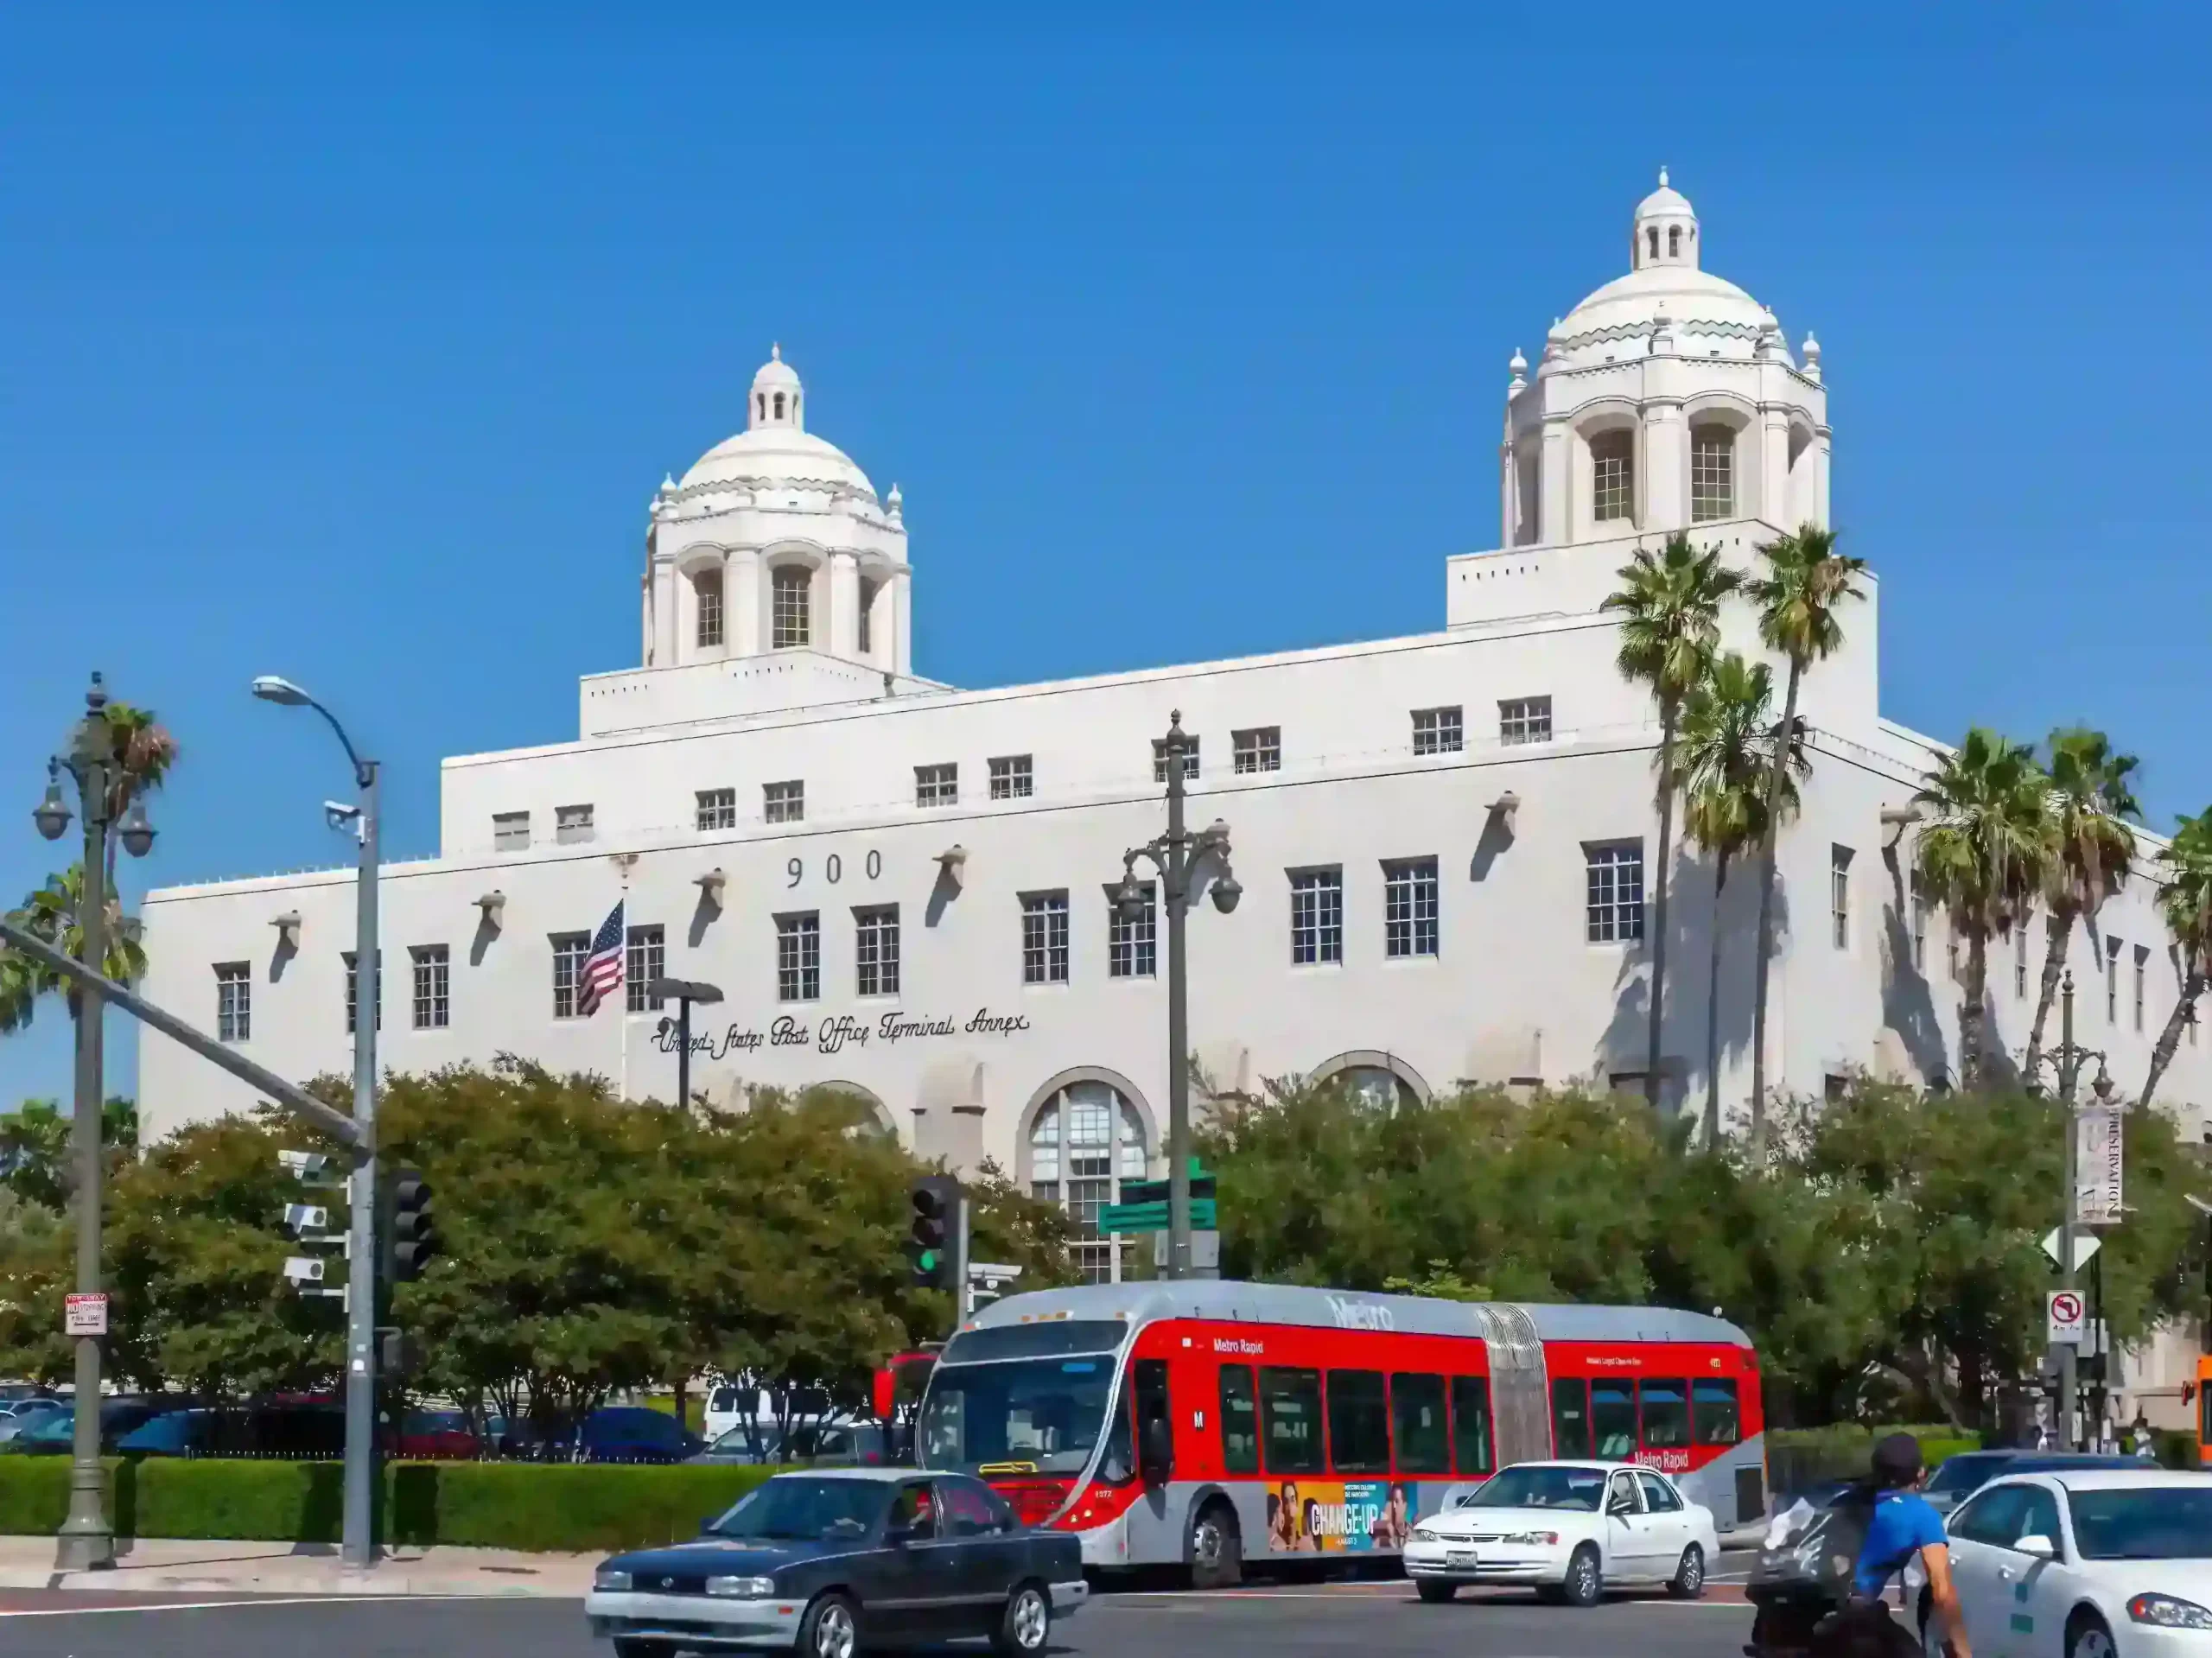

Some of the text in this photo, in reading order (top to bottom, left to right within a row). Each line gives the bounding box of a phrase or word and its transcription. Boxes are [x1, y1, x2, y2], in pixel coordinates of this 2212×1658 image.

[786, 849, 880, 888] 900
[652, 1007, 1030, 1060] Unted States Post Office Terminal Annex
[1324, 1295, 1395, 1331] Metro
[1213, 1337, 1264, 1356] Metro Rapid
[1635, 1451, 1688, 1471] Metro Rapid
